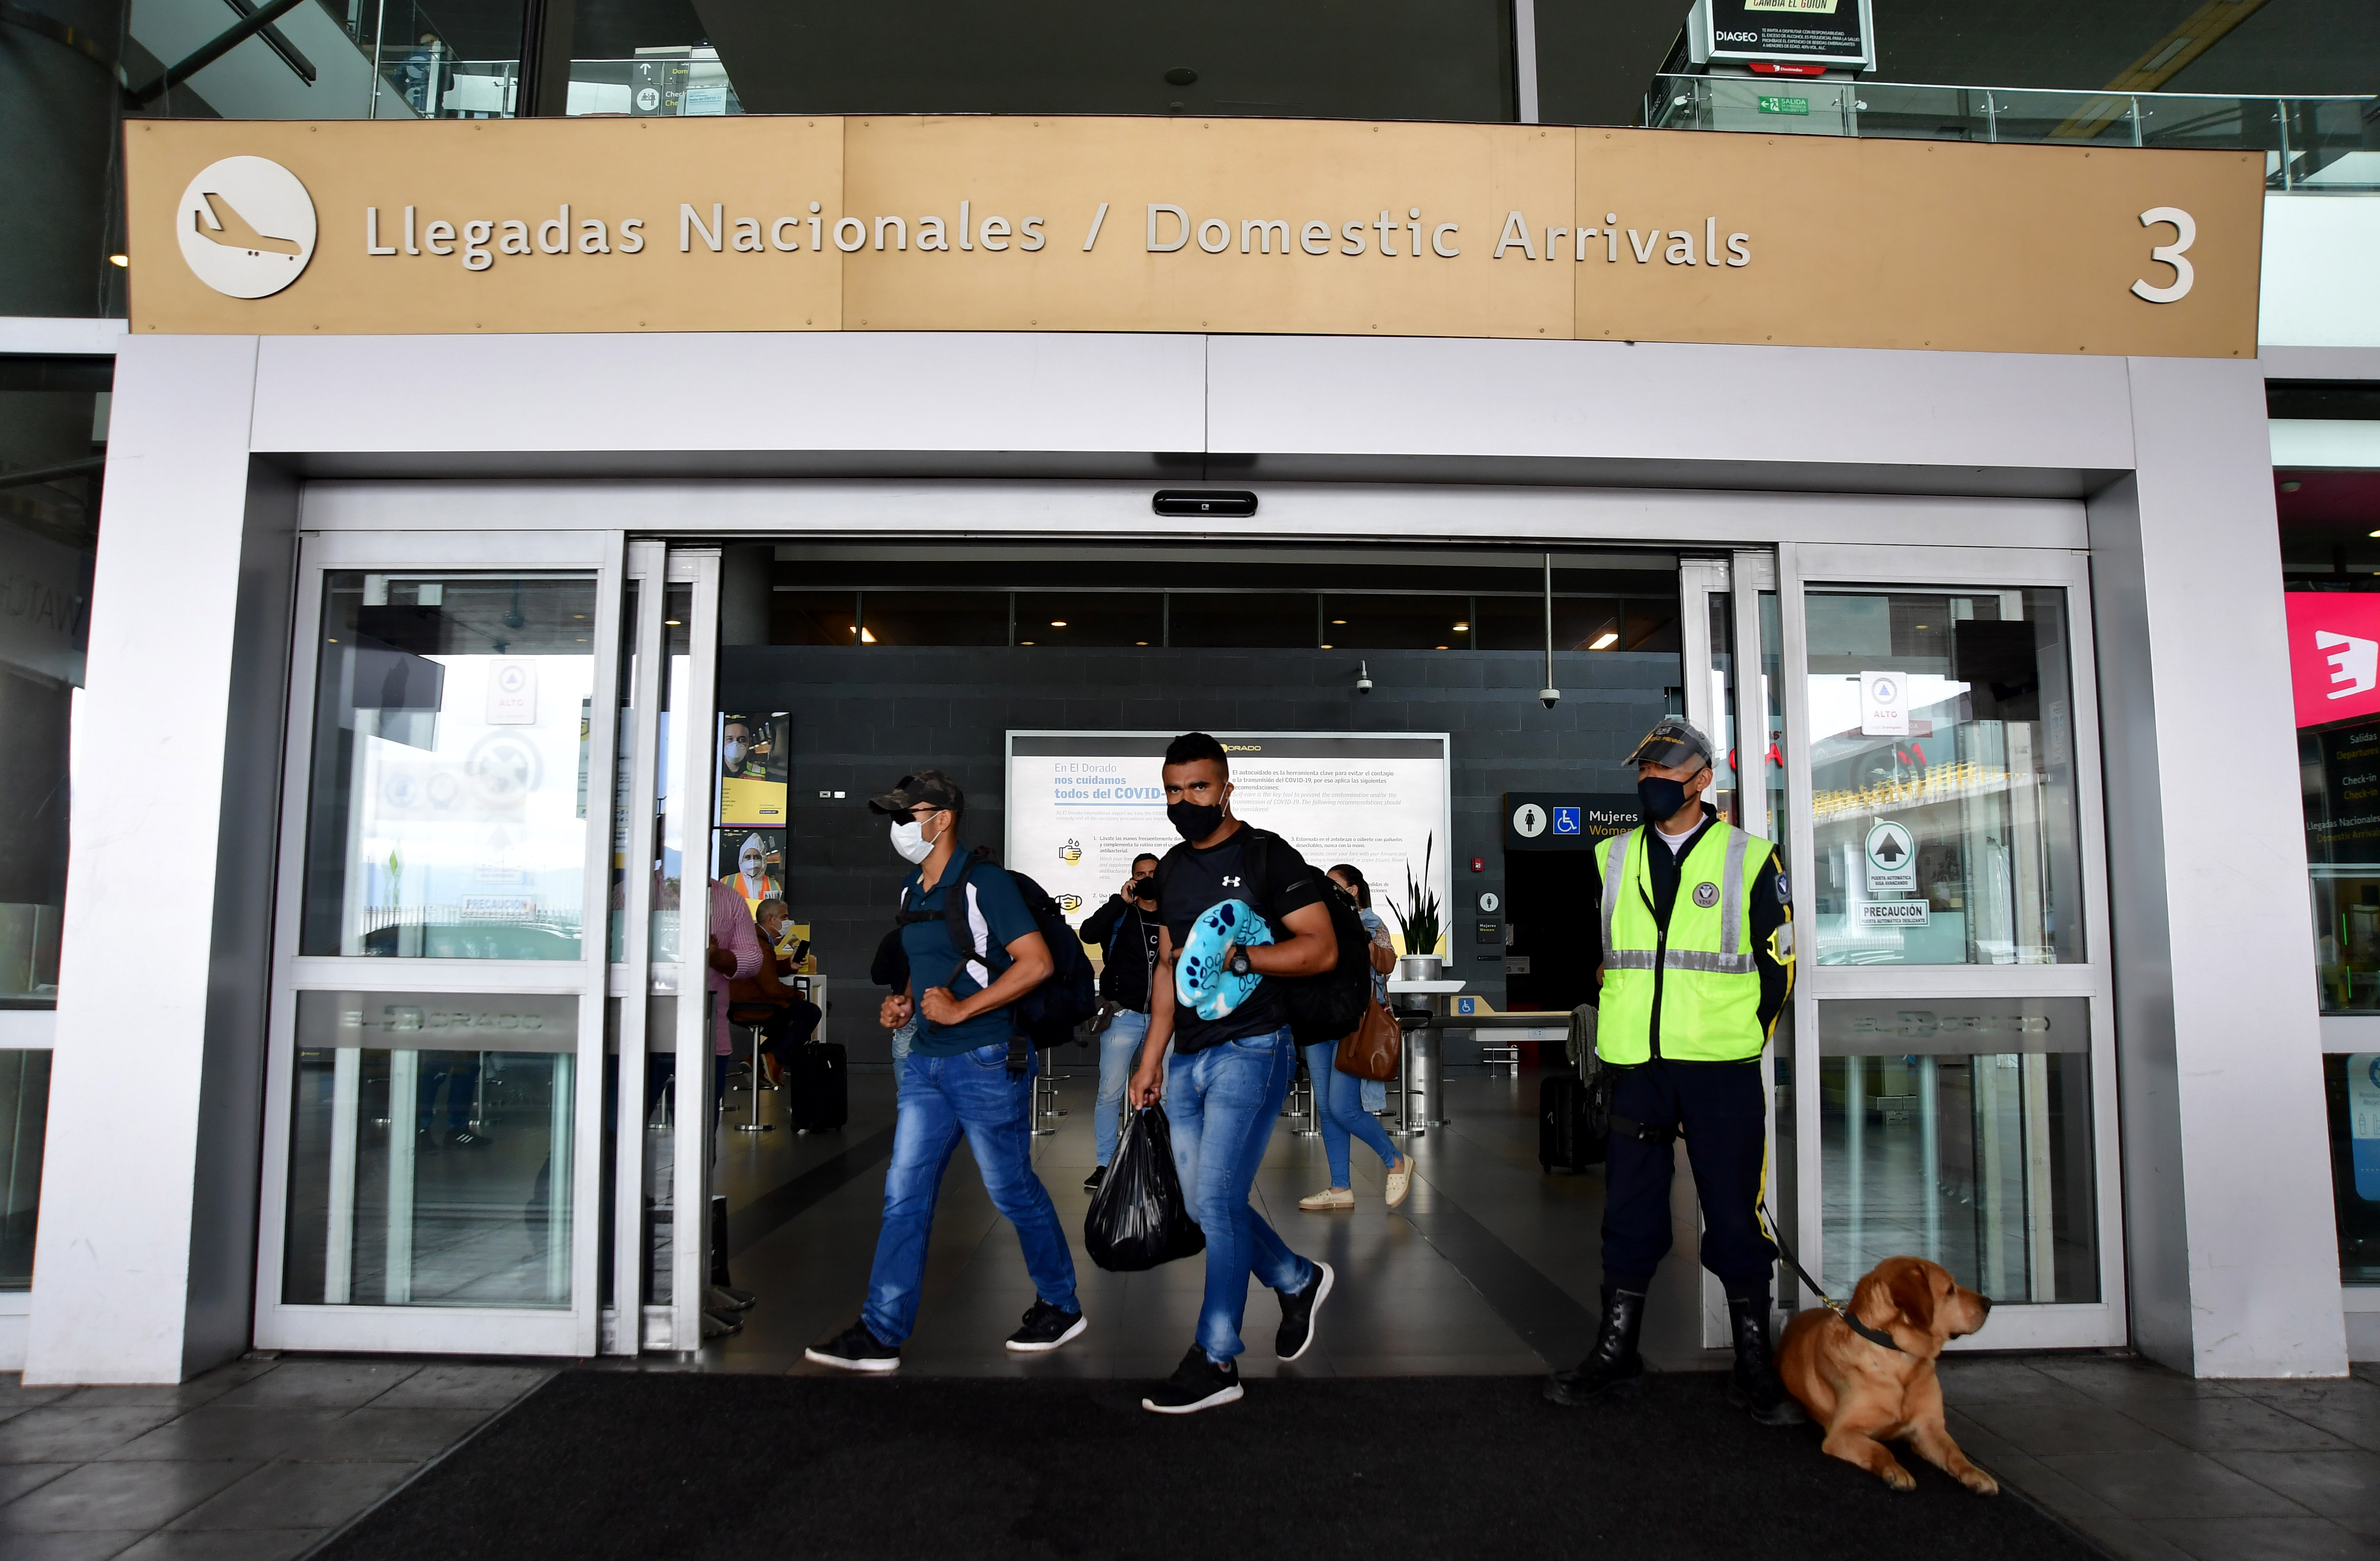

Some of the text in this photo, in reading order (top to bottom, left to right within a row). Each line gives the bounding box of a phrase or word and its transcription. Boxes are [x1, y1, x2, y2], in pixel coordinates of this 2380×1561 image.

[1716, 31, 1758, 42] DIAGEO
[366, 204, 645, 271] Llegadas
[679, 201, 1046, 251] Nacionales
[1145, 203, 1461, 257] Domestic
[1493, 210, 1751, 267] Arrivals
[2130, 206, 2196, 304] 3
[2350, 733, 2377, 744] Salidas
[2336, 747, 2379, 760] Departures
[1055, 763, 1117, 772] En El Dorado
[1076, 775, 1126, 784] cuidamos
[2342, 773, 2377, 785] Check-in
[1054, 788, 1089, 799] todos
[1093, 788, 1111, 799] del
[2344, 788, 2378, 800] Check-in
[1589, 810, 1638, 825] Mujeres
[2306, 813, 2380, 831] Llegadas Nacionales
[1863, 904, 1922, 917] PRECAUCIÓN
